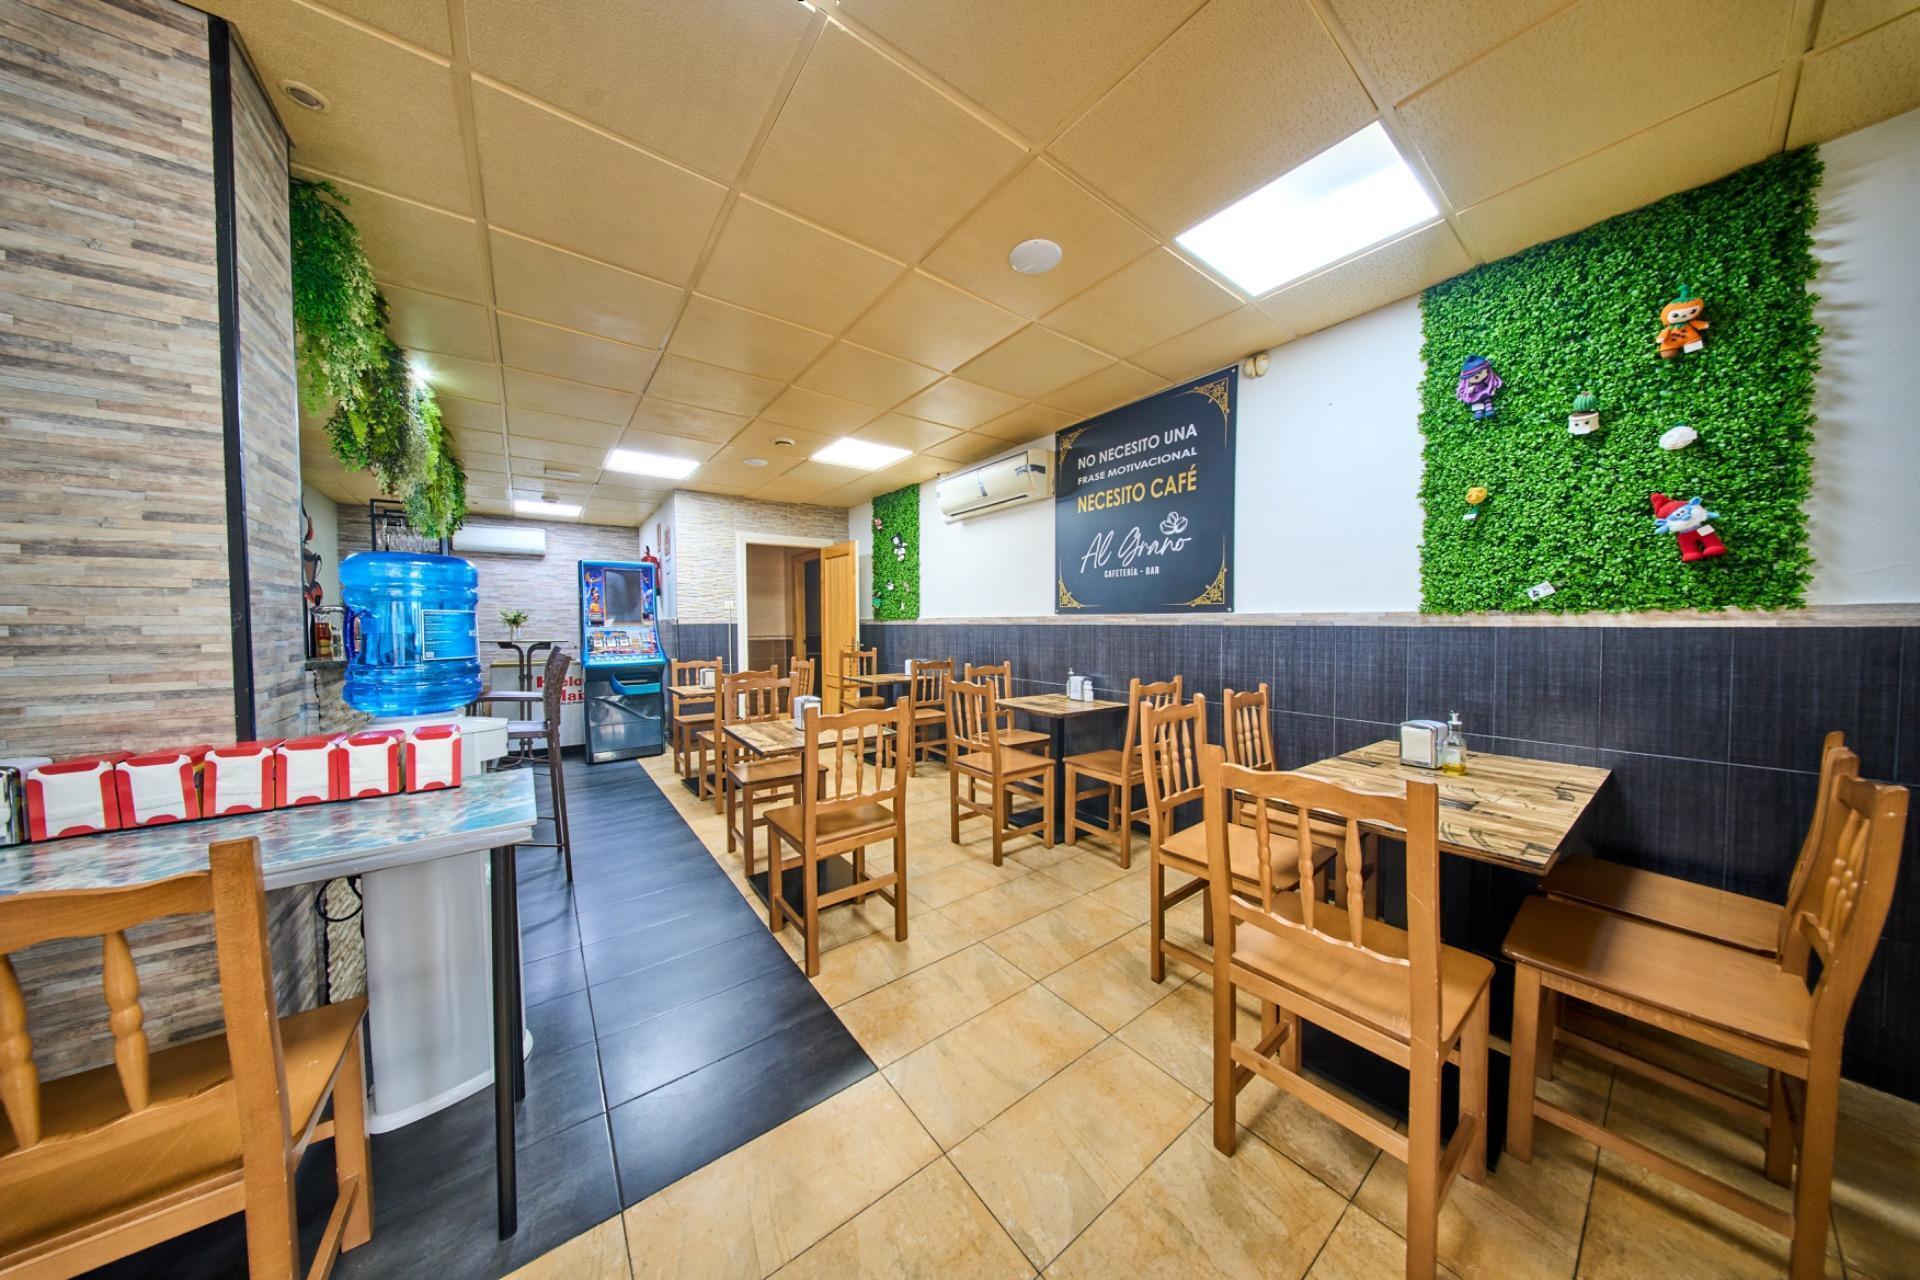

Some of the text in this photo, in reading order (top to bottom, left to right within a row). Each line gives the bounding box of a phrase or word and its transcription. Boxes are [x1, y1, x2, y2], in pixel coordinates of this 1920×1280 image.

[1077, 423, 1198, 470] NO NECESITO UNA
[1077, 447, 1198, 485] FRASE MOTIVACIONAL
[1077, 463, 1197, 513] NECESITO CAFÉ
[1079, 526, 1193, 574] Al Grano
[1104, 566, 1138, 578] CAFETERÍA
[1145, 565, 1161, 576] BAR
